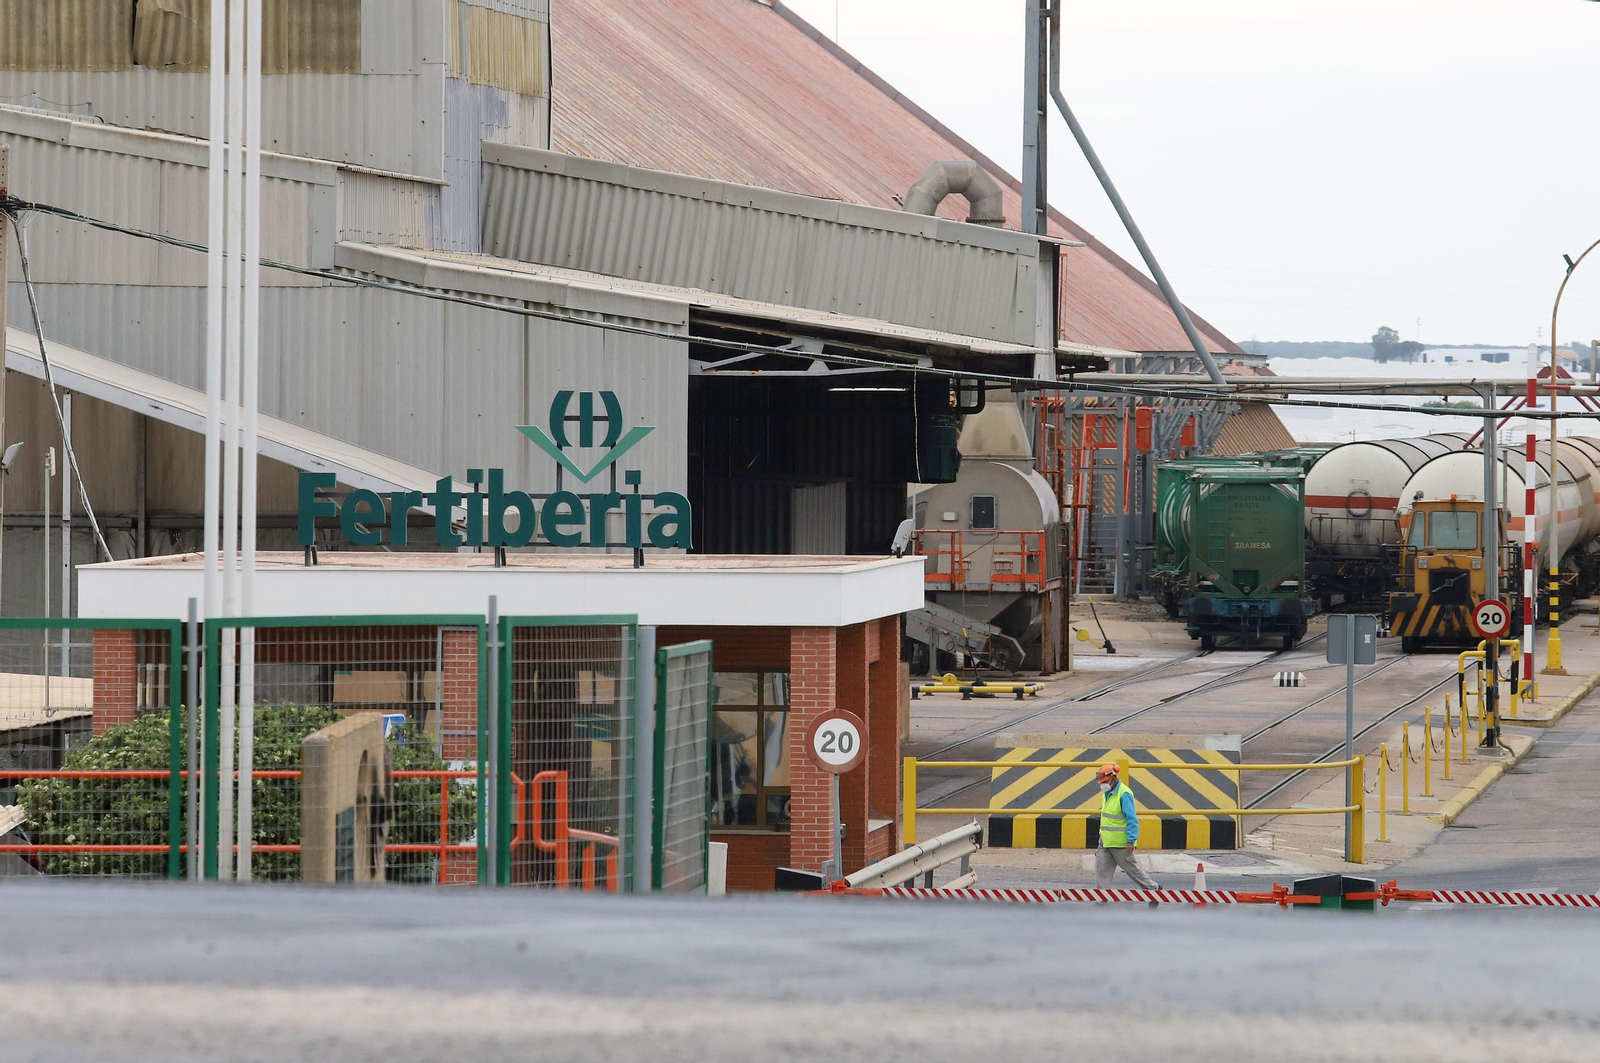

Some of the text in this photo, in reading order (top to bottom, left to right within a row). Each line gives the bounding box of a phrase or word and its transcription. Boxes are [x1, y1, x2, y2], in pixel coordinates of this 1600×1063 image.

[298, 468, 693, 549] Fertiberia
[1480, 612, 1502, 625] 20
[820, 730, 853, 754] 20
